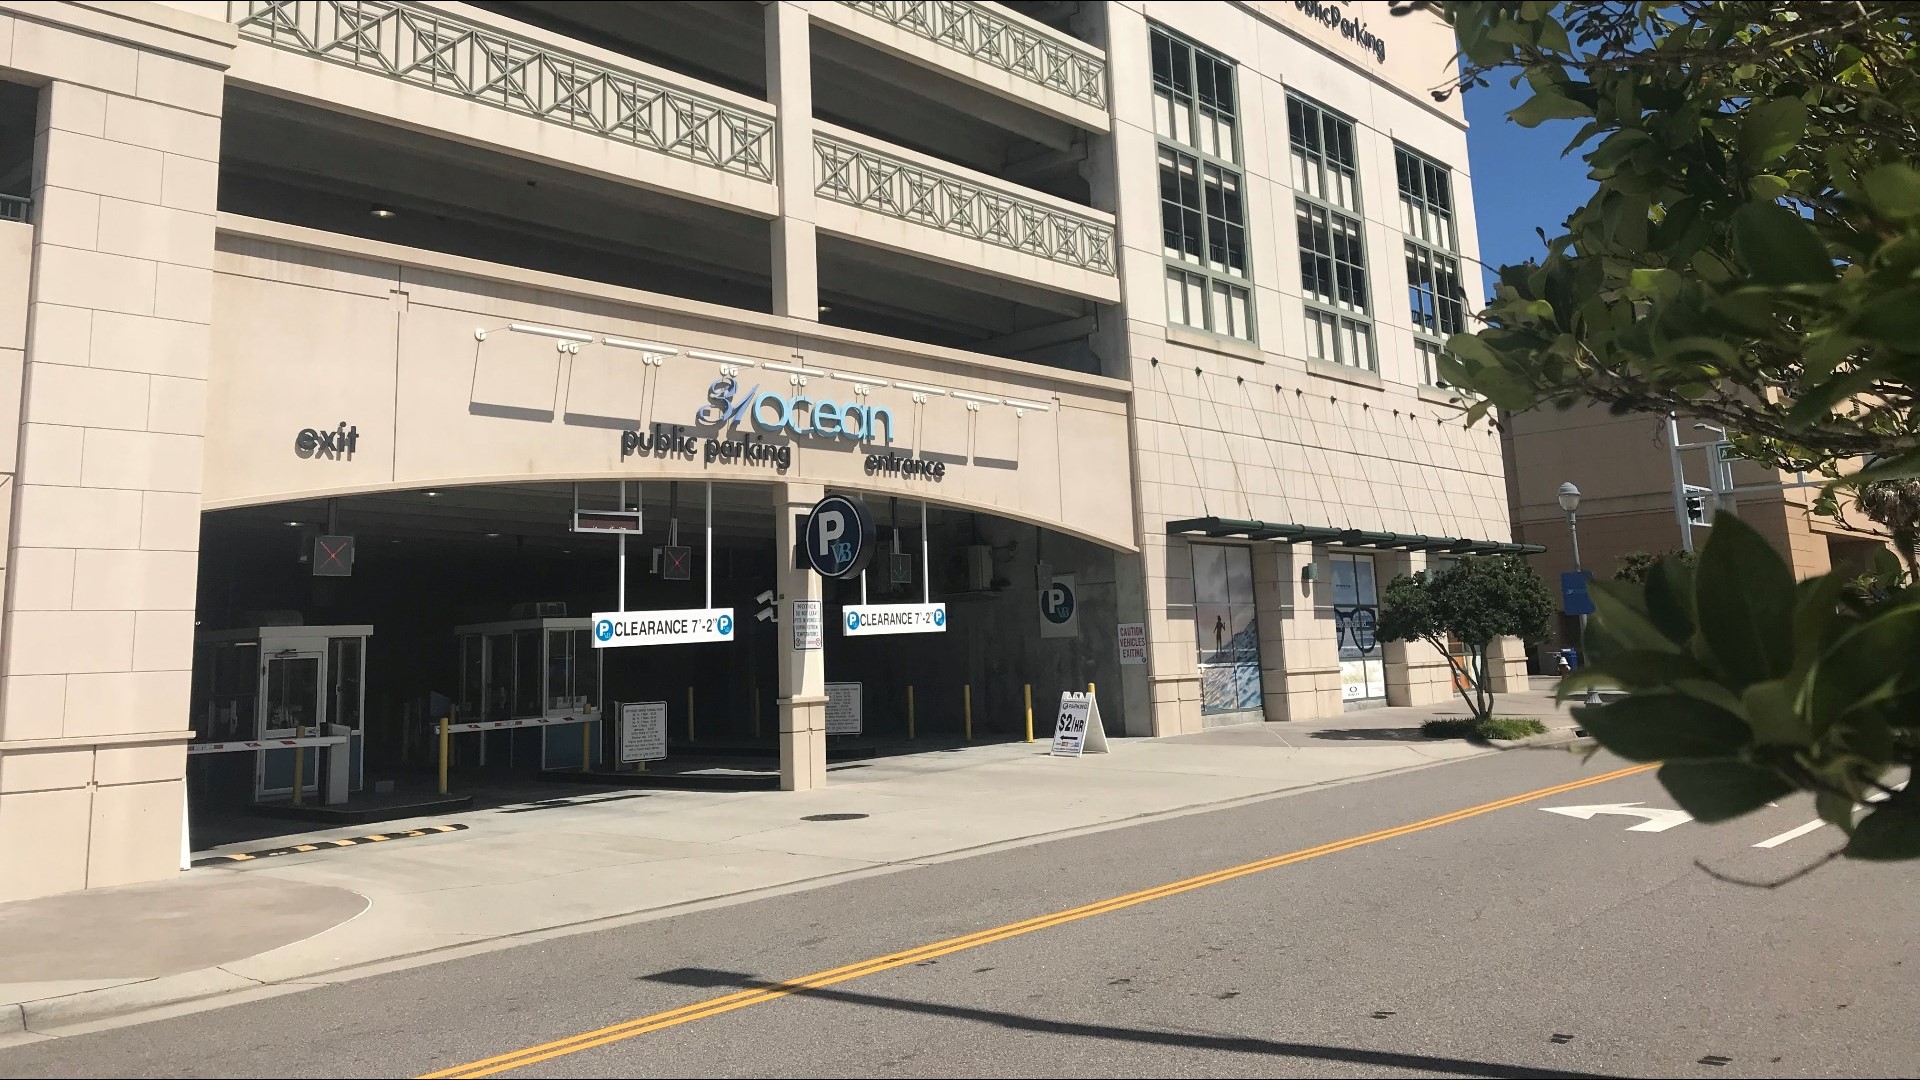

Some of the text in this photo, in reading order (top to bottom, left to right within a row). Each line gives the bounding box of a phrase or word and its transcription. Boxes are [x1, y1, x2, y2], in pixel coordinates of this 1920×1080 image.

[753, 390, 895, 442] ocean
[295, 421, 360, 458] exit
[622, 424, 791, 470] public parking
[864, 451, 946, 478] entrance
[818, 511, 845, 556] P
[1048, 589, 1065, 613] P
[614, 619, 688, 637] CLEARANCE
[860, 612, 913, 627] CLEARANCE
[1119, 637, 1146, 647] VEHICLES
[1120, 626, 1143, 636] CAUTION
[1122, 648, 1144, 658] EXITING
[1058, 712, 1085, 732] $2/HR
